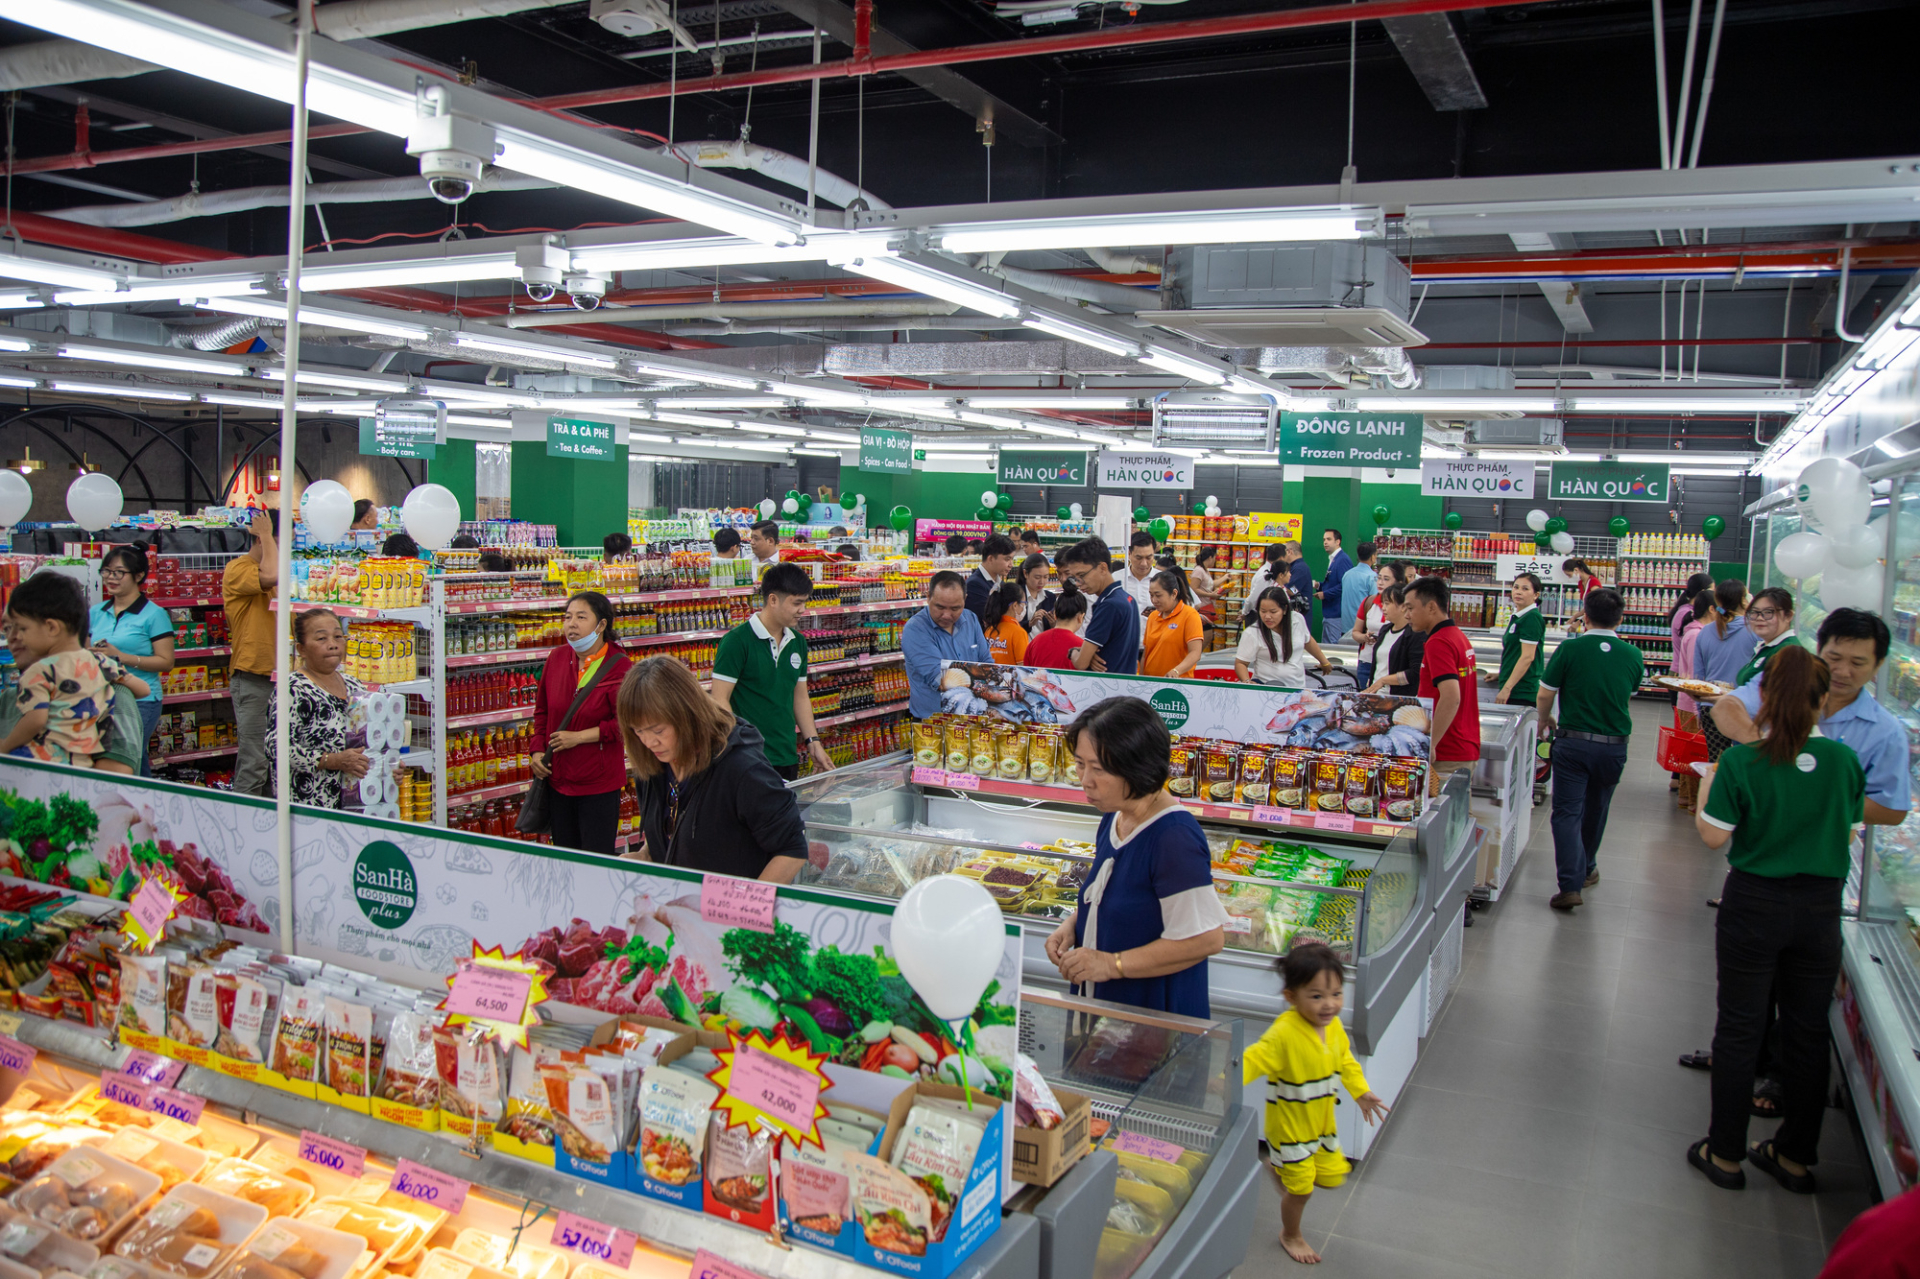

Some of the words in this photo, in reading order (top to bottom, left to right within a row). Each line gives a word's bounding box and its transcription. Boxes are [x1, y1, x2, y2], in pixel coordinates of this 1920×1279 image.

[553, 422, 569, 434] TRÀ
[571, 425, 578, 436] &
[580, 424, 592, 437] CÀ
[594, 427, 609, 439] PHÊ
[1296, 416, 1350, 435] ĐÔNG
[1356, 420, 1405, 438] LẠNH
[560, 443, 572, 452] Tea
[574, 444, 579, 453] &
[581, 445, 603, 455] Coffee
[863, 435, 874, 446] GIA
[876, 436, 882, 449] VỊ
[887, 435, 896, 448] ĐỒ
[897, 438, 910, 451] HỘP
[381, 446, 399, 456] Body
[1300, 446, 1344, 459] Frozen
[1349, 448, 1402, 461] Product
[865, 456, 880, 468] Spices
[885, 458, 894, 467] Can
[896, 459, 907, 468] Food
[1120, 456, 1143, 466] THỰC
[1145, 455, 1171, 465] PHẨM
[1446, 463, 1474, 473] THỰC
[1477, 462, 1507, 472] PHẨM
[1005, 465, 1033, 479] HÀN
[1037, 462, 1078, 482] QUỐC
[1107, 466, 1137, 481] HÀN
[1141, 464, 1184, 484] QUỐC
[1432, 474, 1468, 490] HÀN
[1472, 472, 1523, 493] QUỐC
[1560, 477, 1598, 494] HÀN
[1603, 474, 1658, 497] QUỐC
[1515, 560, 1553, 574] 국순당
[1151, 699, 1187, 712] SanHà
[1171, 750, 1185, 759] SG
[1211, 755, 1225, 763] SG
[1247, 756, 1262, 765] SG
[1279, 761, 1293, 770] SG
[1320, 765, 1335, 773] SG
[1350, 768, 1364, 777] SG
[1390, 772, 1405, 780] SG
[356, 862, 414, 892] SanHà
[361, 888, 410, 906] FOODSTORE
[368, 902, 403, 921] plus
[346, 924, 363, 935] Thực
[365, 930, 385, 940] phẩm
[387, 934, 399, 943] cho
[402, 938, 415, 947] mọi
[417, 940, 431, 950] nhà
[475, 997, 508, 1012] 64,500
[761, 1089, 796, 1114] 42,000
[924, 1156, 944, 1172] Kim
[946, 1164, 965, 1180] Chi
